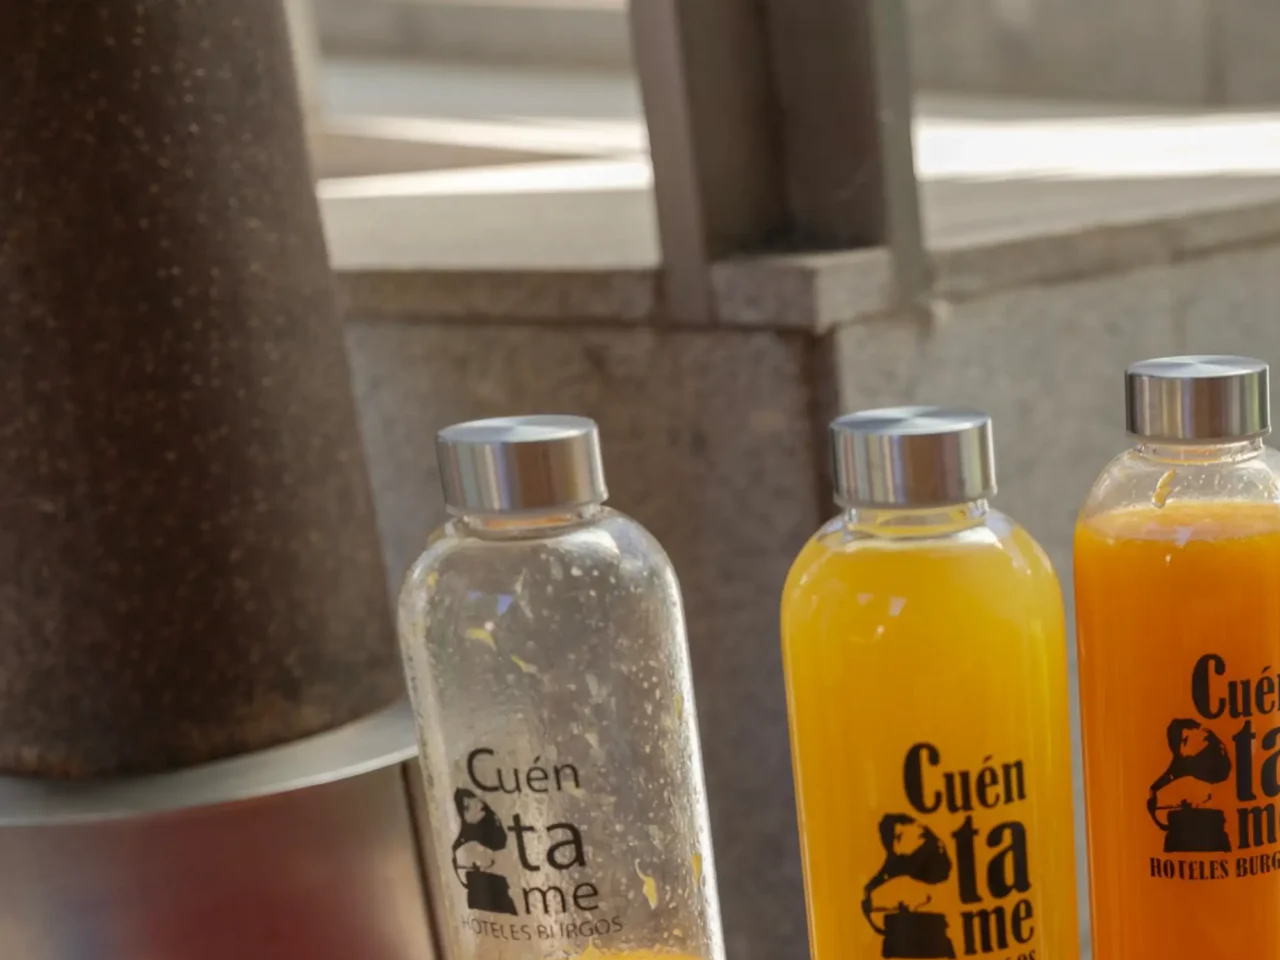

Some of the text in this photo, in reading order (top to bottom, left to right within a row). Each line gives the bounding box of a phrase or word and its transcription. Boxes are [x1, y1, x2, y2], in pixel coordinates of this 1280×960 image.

[467, 747, 581, 794] Cuén
[903, 741, 1027, 814] Cuén
[507, 813, 586, 871] ta
[952, 815, 1032, 904] ta
[1149, 857, 1229, 881] HOTELES
[523, 881, 599, 916] me
[461, 915, 624, 941] HOTELES BURGOS
[960, 898, 1034, 956] me
